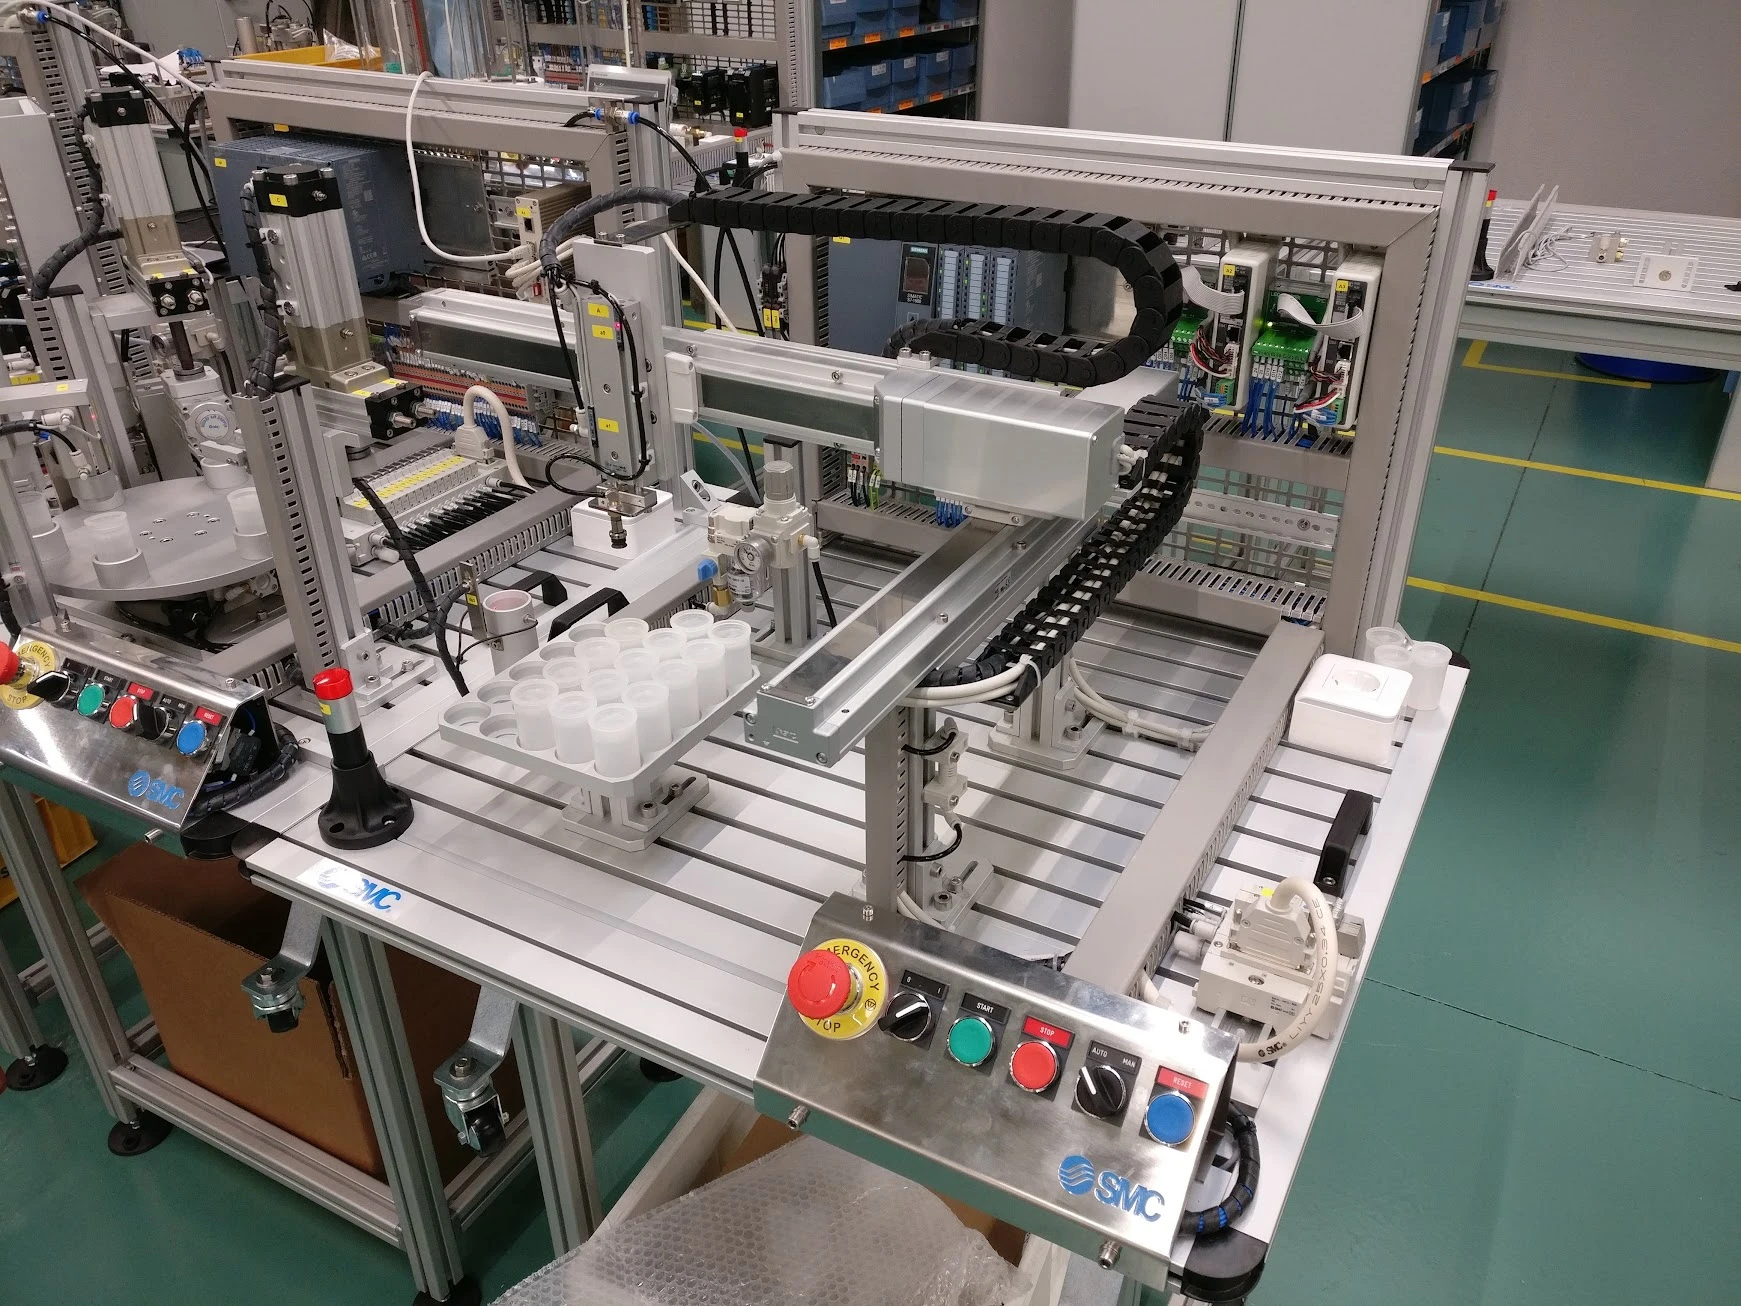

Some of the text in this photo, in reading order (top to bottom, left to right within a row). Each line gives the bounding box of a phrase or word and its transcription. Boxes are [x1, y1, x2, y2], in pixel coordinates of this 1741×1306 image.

[6, 694, 27, 704] STOP
[145, 779, 185, 810] SMC
[1312, 898, 1324, 919] CE
[827, 945, 880, 992] ERGENCY
[976, 1002, 994, 1014] START
[810, 1018, 841, 1033] TOP
[1039, 1026, 1055, 1037] STOP
[1091, 1047, 1136, 1068] AUTO MAN
[1172, 1076, 1193, 1090] RESET
[1094, 1170, 1165, 1222] SMC
